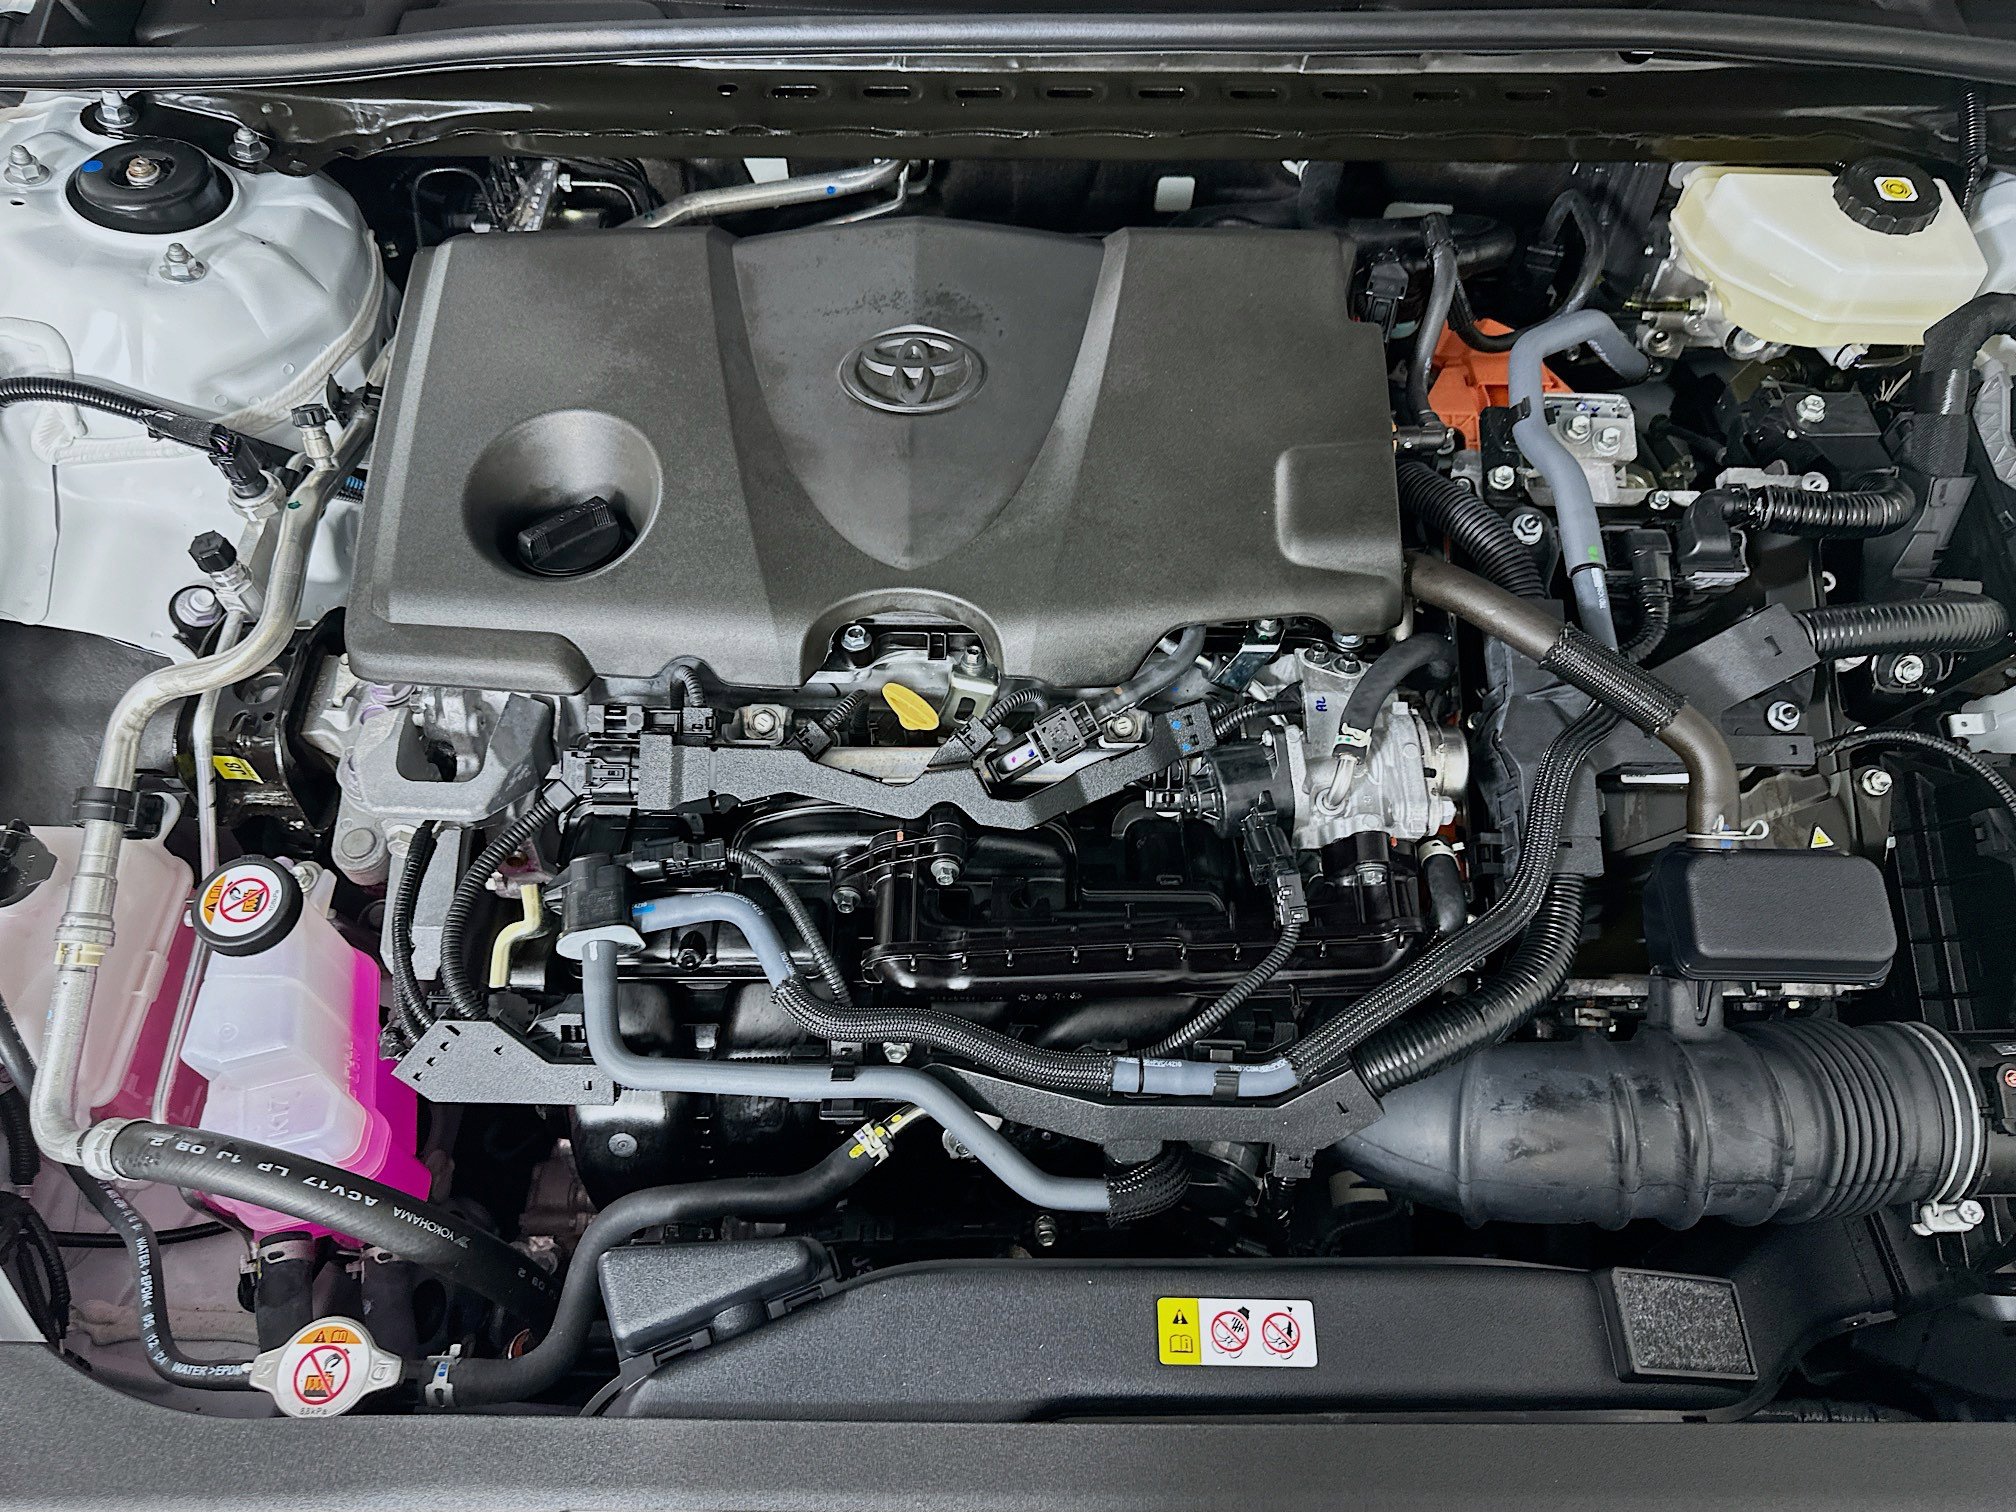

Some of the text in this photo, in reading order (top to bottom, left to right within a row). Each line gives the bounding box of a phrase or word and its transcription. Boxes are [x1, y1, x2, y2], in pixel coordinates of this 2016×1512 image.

[257, 1162, 291, 1177] LP
[302, 1176, 380, 1208] ACV17
[392, 1206, 455, 1241] YOKOHAMA
[135, 1236, 151, 1269] WATER
[171, 1361, 208, 1376] WATER
